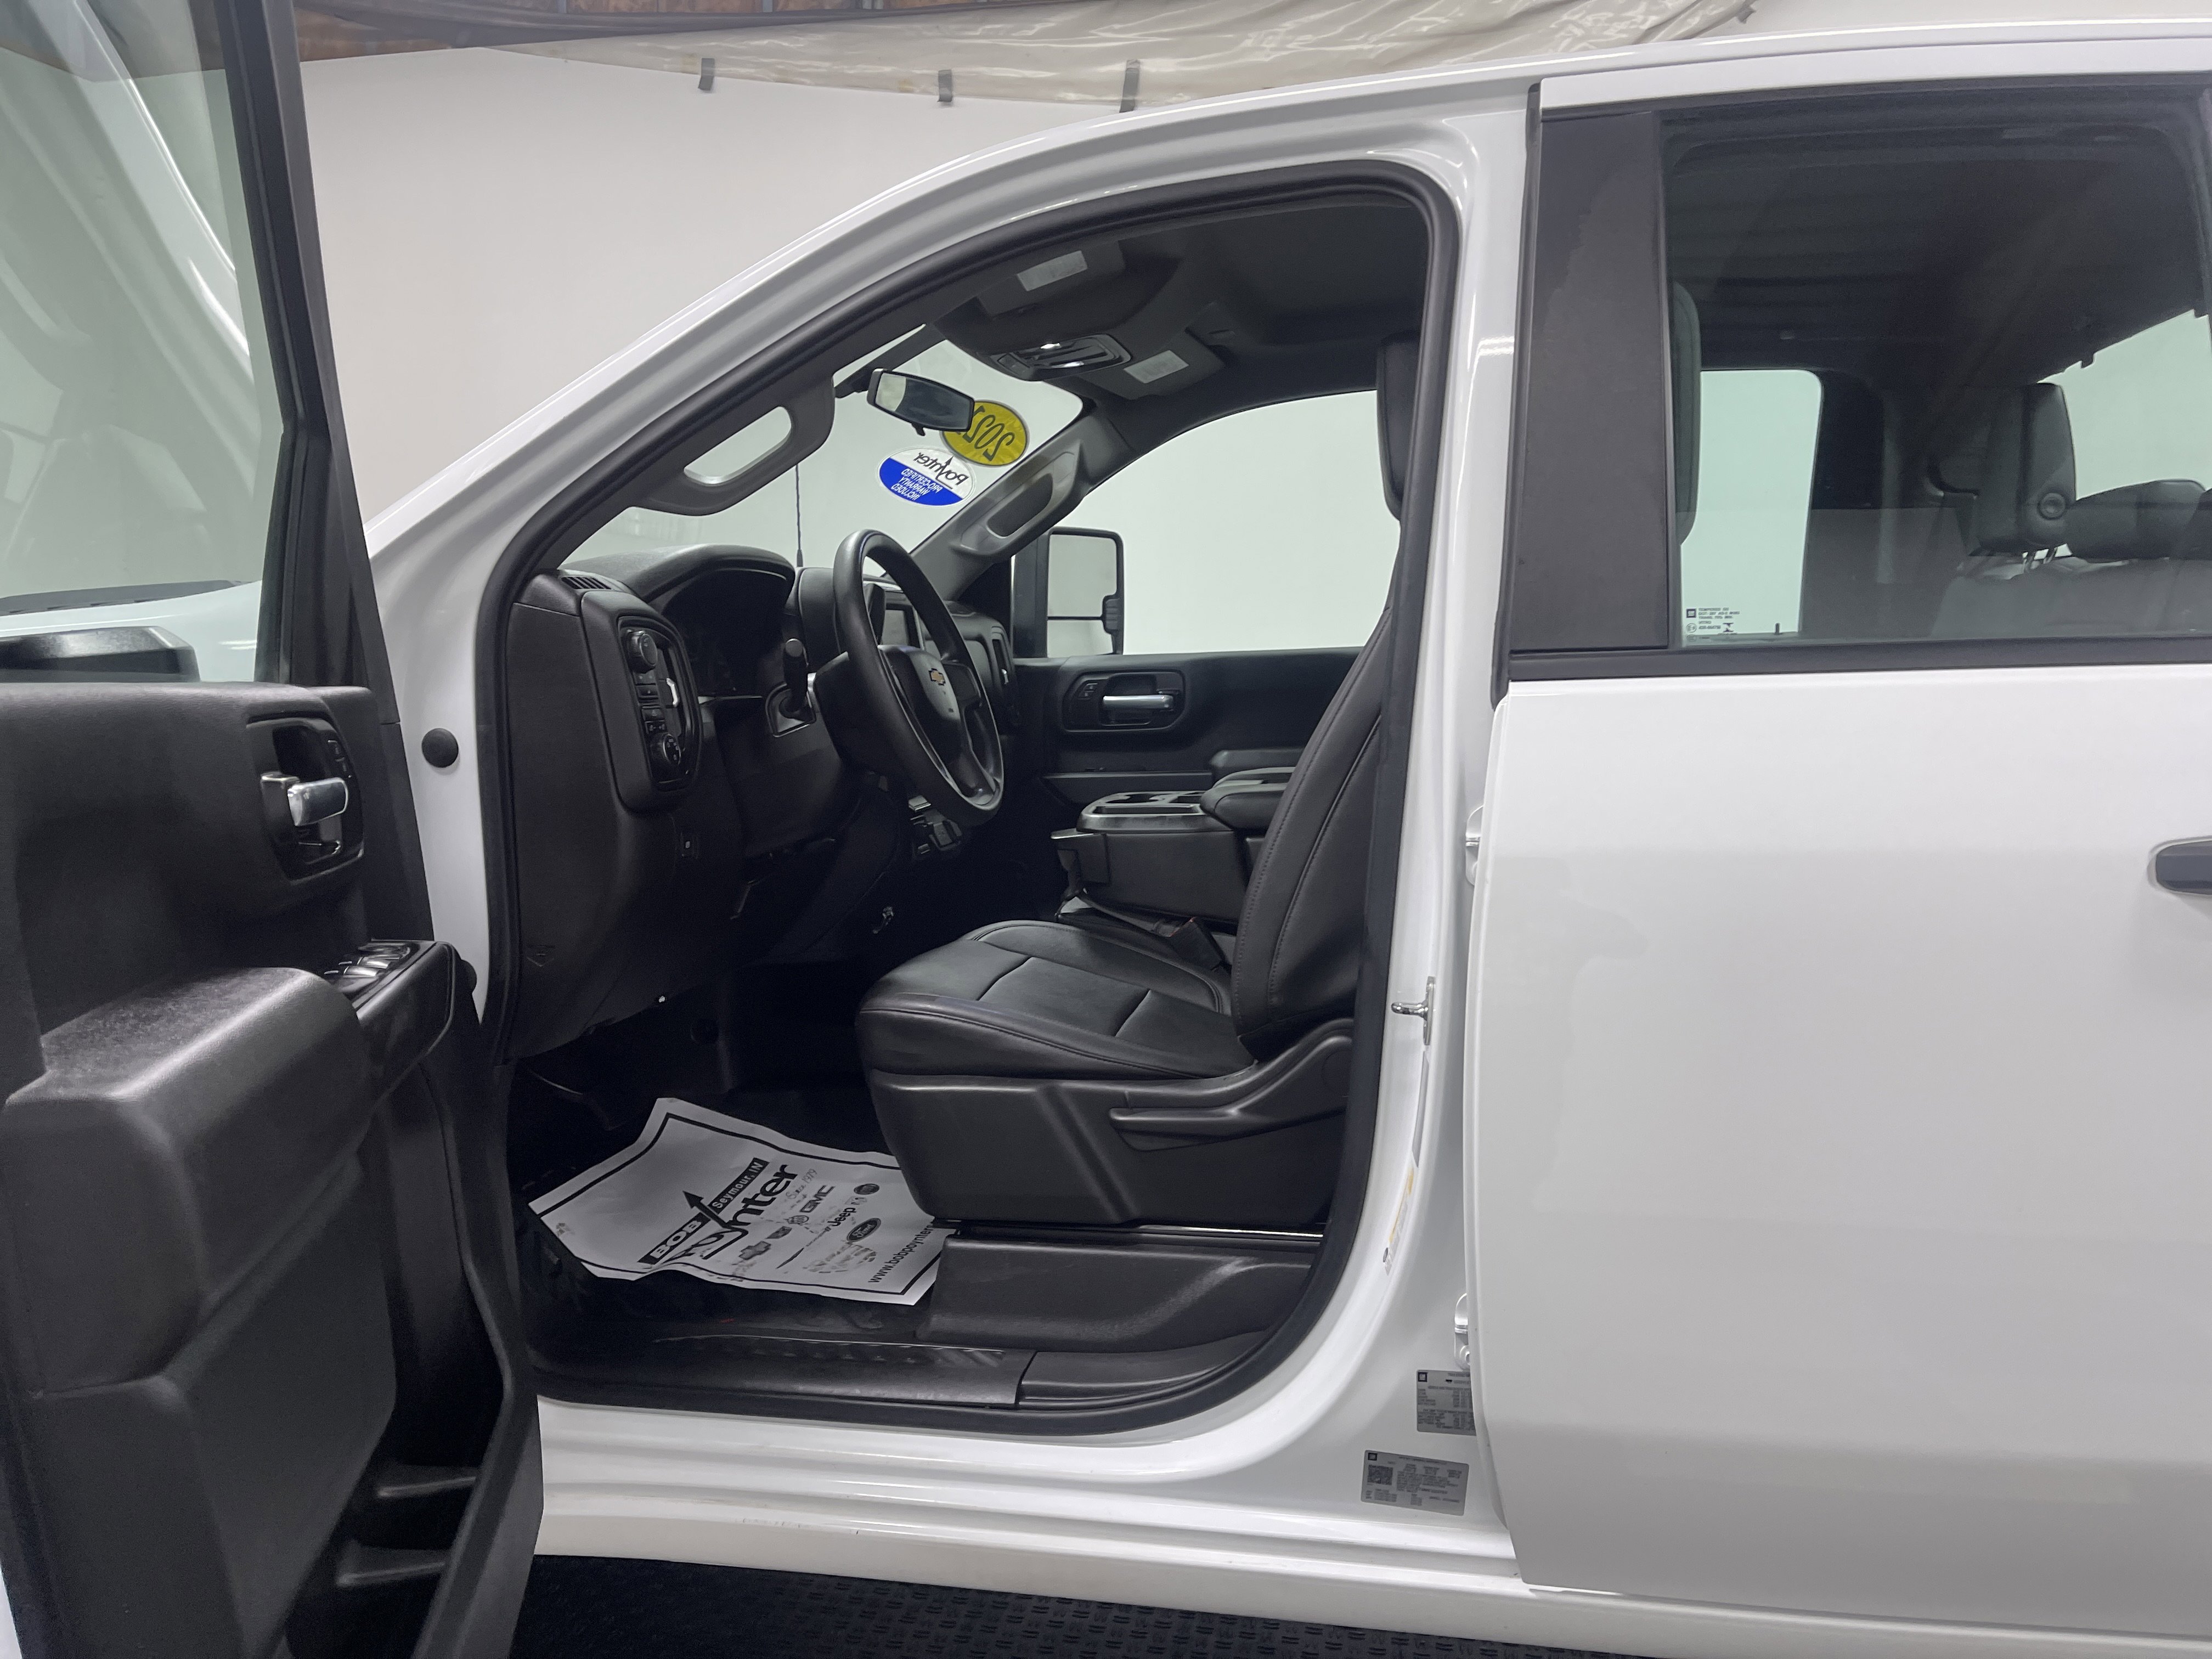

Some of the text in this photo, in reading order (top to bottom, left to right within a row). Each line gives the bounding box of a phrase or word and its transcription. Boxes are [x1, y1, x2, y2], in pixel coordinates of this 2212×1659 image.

[749, 1161, 763, 1173] IN
[802, 1168, 817, 1184] 1979
[799, 1185, 836, 1213] GMC
[827, 1207, 857, 1227] Jeep
[650, 1220, 702, 1259] BOB
[851, 1223, 875, 1238] Ford
